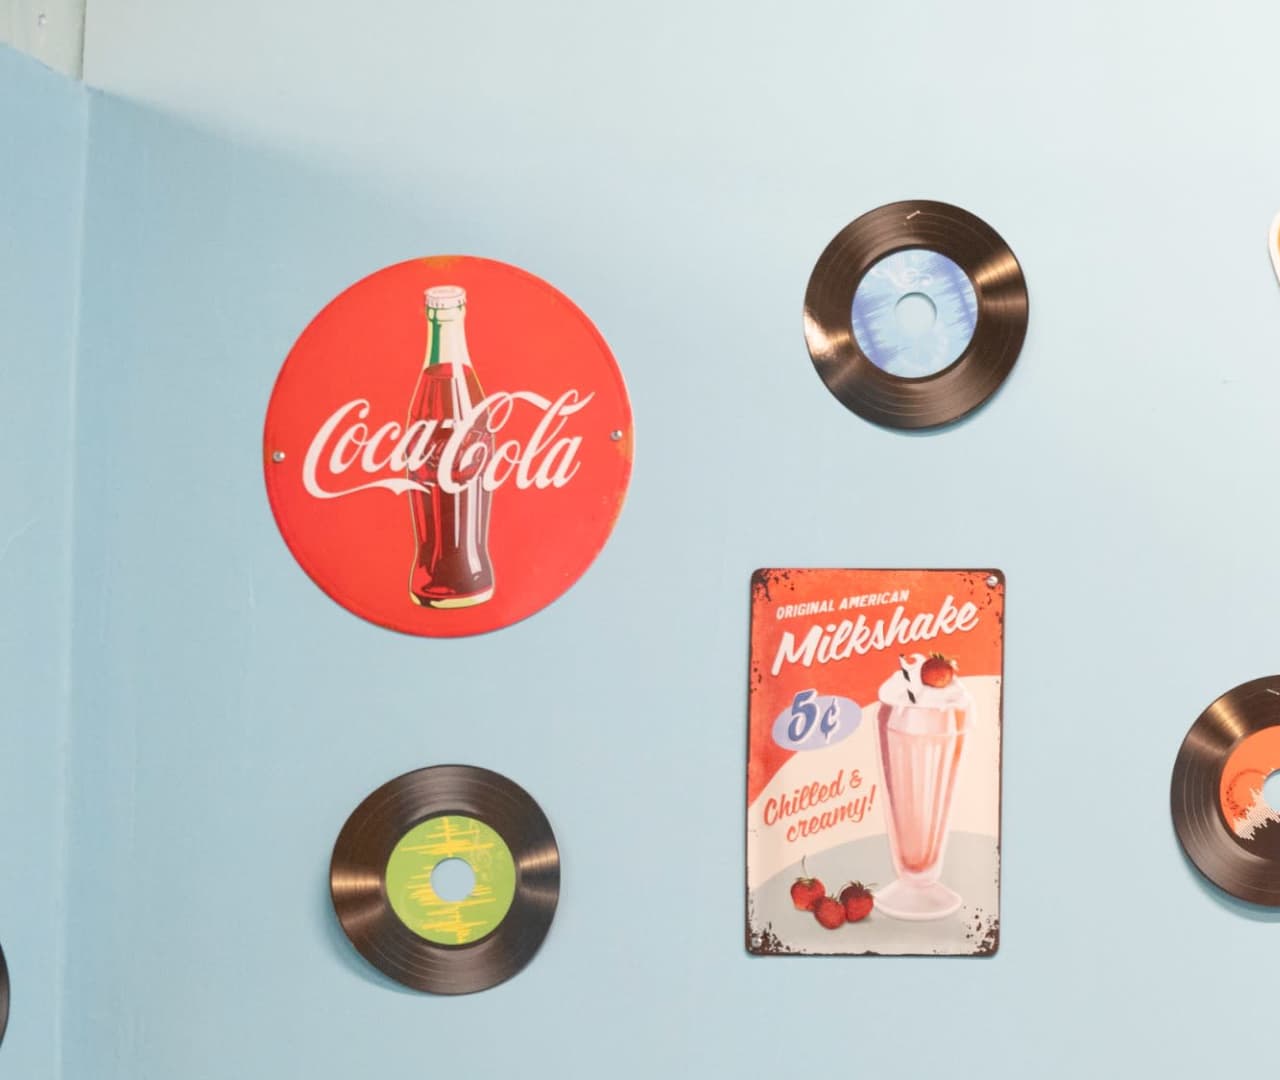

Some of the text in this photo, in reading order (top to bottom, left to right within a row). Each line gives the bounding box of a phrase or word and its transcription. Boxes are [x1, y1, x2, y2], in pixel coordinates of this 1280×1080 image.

[302, 389, 595, 499] Coca-Cola
[776, 590, 910, 620] ORIGINAL AMERICAN
[771, 594, 979, 677] Milkshake
[787, 688, 841, 745] 5¢
[763, 769, 863, 826] Chilled &
[786, 784, 876, 843] creamy!
